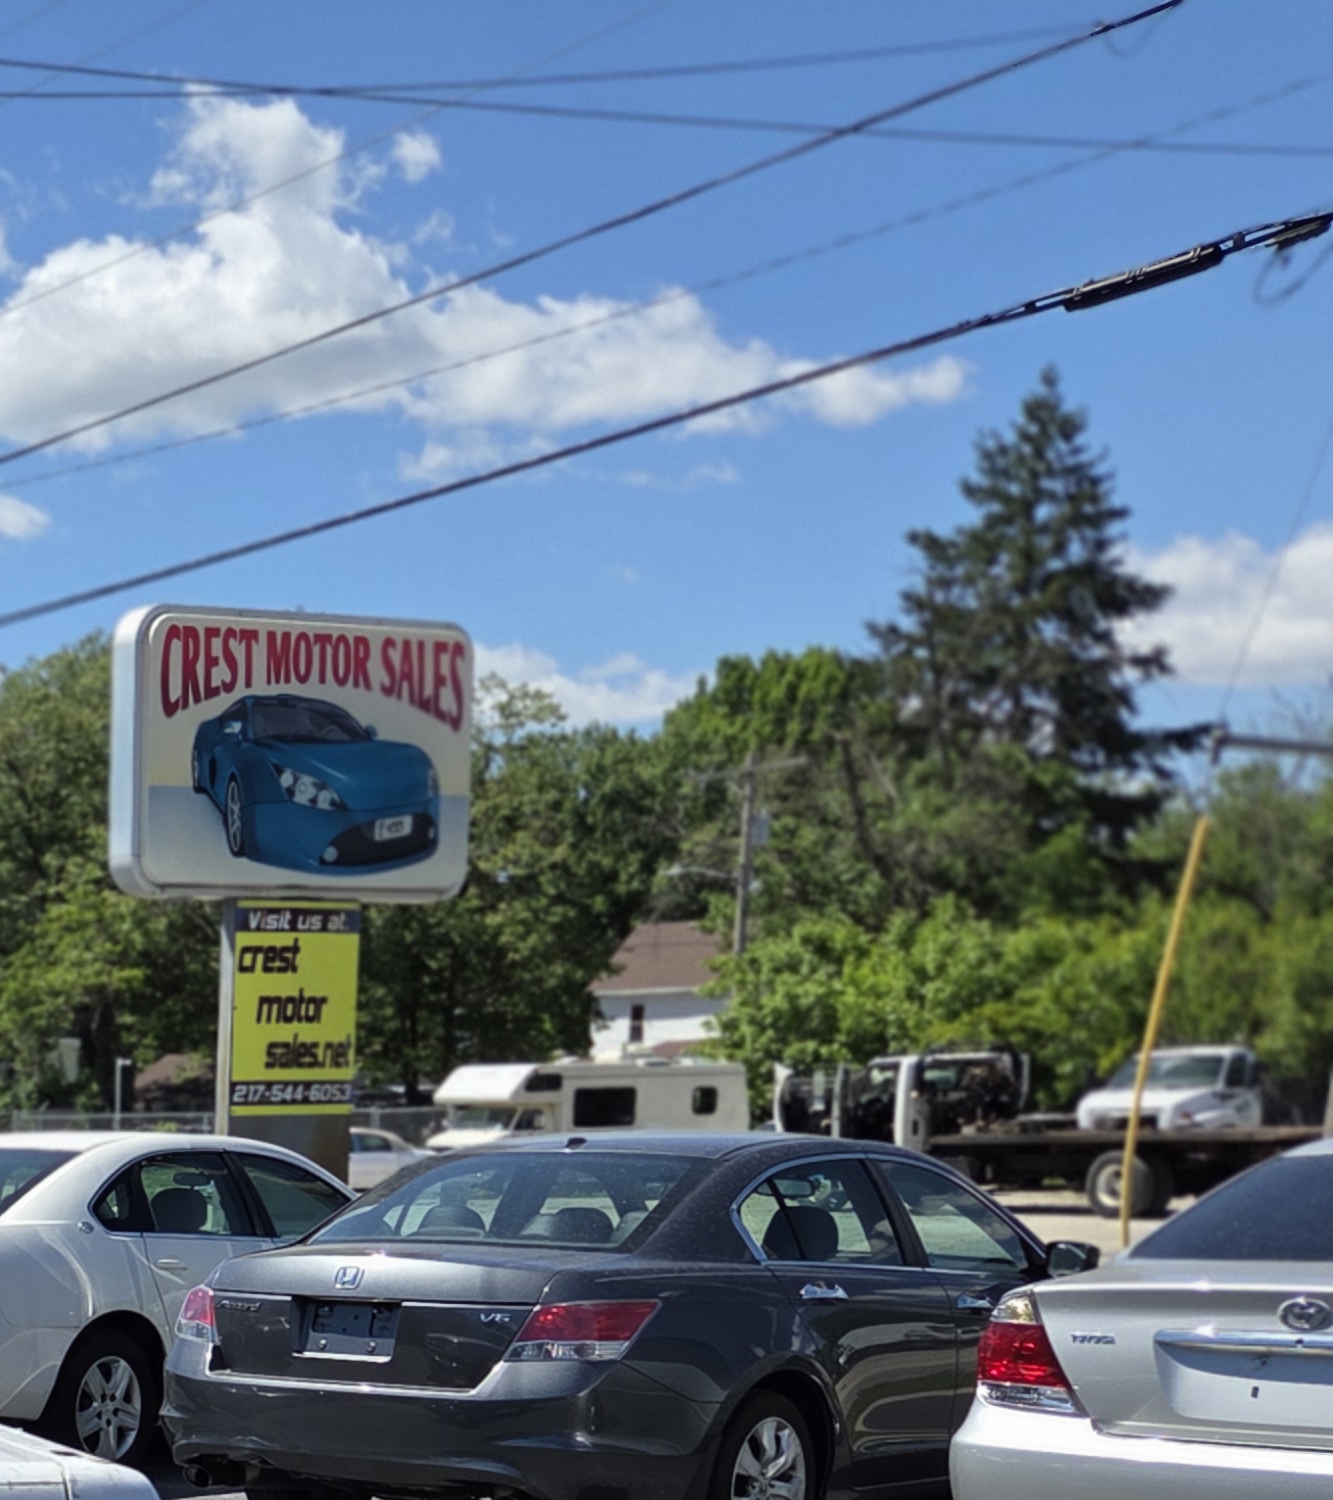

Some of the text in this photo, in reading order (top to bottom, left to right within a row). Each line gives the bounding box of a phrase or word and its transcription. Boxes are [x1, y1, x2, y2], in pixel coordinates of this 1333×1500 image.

[160, 623, 466, 733] CREST MOTOR SALES
[248, 909, 292, 931] Visit
[296, 912, 325, 931] us
[237, 937, 302, 974] crest
[255, 987, 329, 1025] motor
[264, 1032, 352, 1070] sales.net
[232, 1083, 352, 1103] 217-544-6053
[480, 1312, 512, 1324] V6
